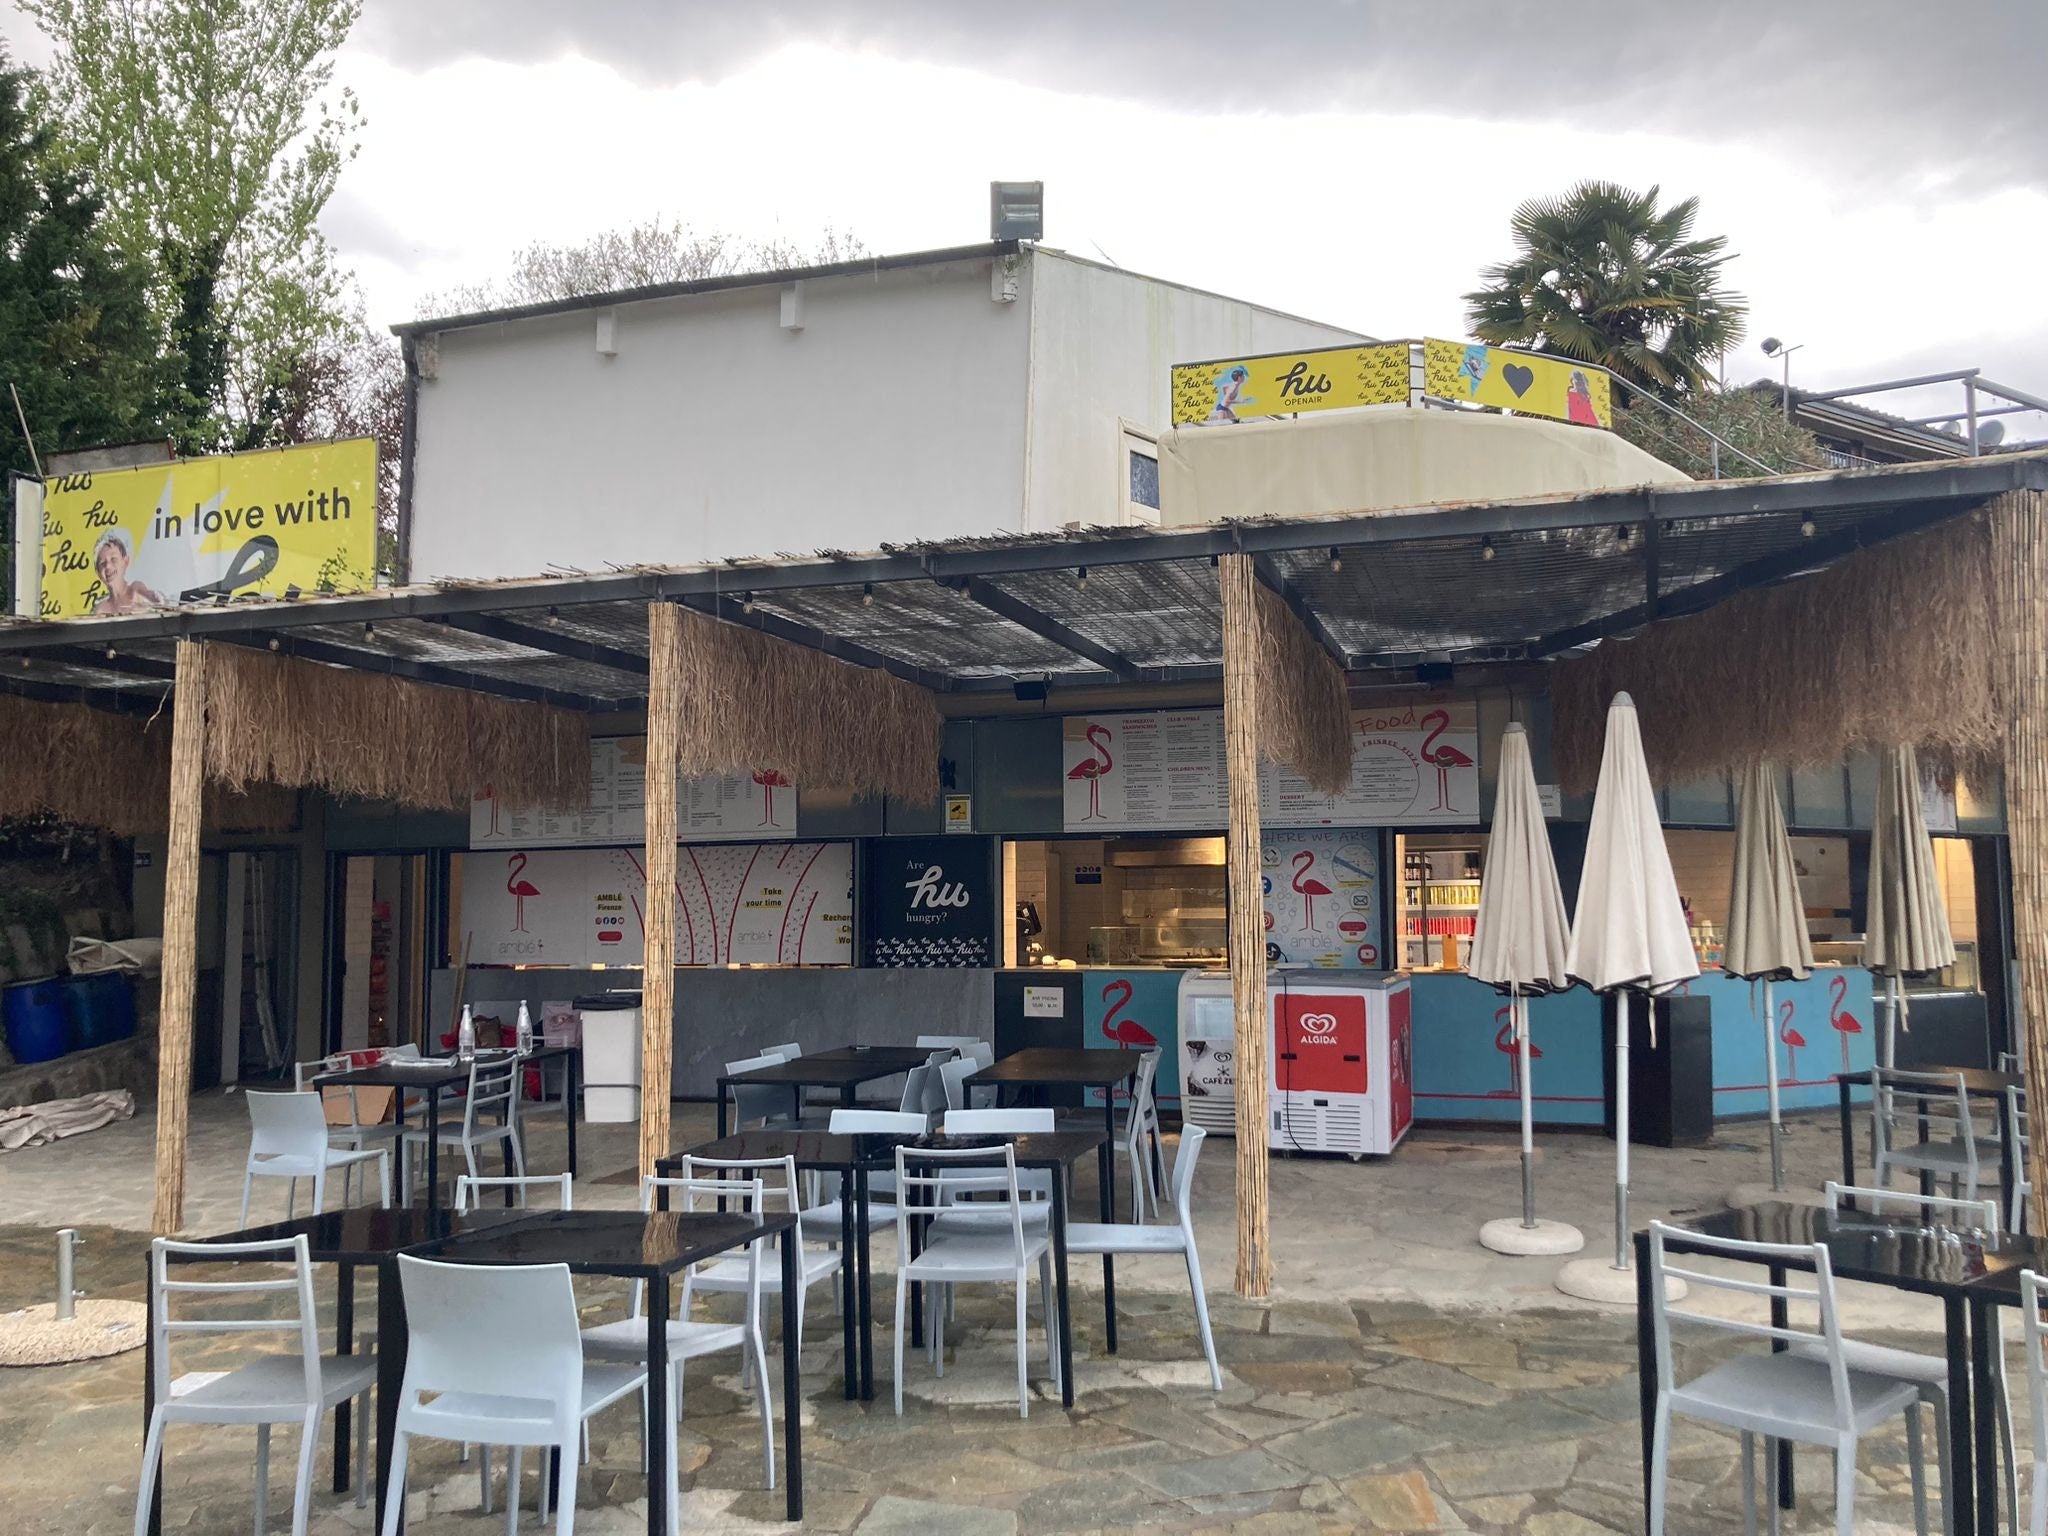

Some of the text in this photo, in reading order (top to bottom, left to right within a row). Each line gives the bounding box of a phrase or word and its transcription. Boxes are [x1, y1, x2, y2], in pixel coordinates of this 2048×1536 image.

[1431, 349, 1447, 363] hu
[1379, 356, 1399, 369] hu
[1275, 361, 1332, 397] hu
[1379, 376, 1400, 388] hu
[1431, 369, 1448, 383] hu
[1182, 377, 1200, 389] hu
[1182, 396, 1201, 408] hu
[1284, 396, 1322, 407] OPENAIR
[83, 500, 119, 528] hu
[155, 486, 351, 540] in love with
[50, 540, 90, 574] hu
[1355, 705, 1416, 736] Food
[1312, 831, 1331, 842] WE
[1341, 831, 1369, 842] ARE
[906, 860, 925, 870] Are
[905, 865, 970, 909] hu
[597, 892, 622, 901] AMBLÉ
[597, 903, 622, 911] Firenze
[765, 899, 782, 907] time
[906, 911, 948, 925] hungry?
[1301, 1035, 1336, 1045] ALGIDA
